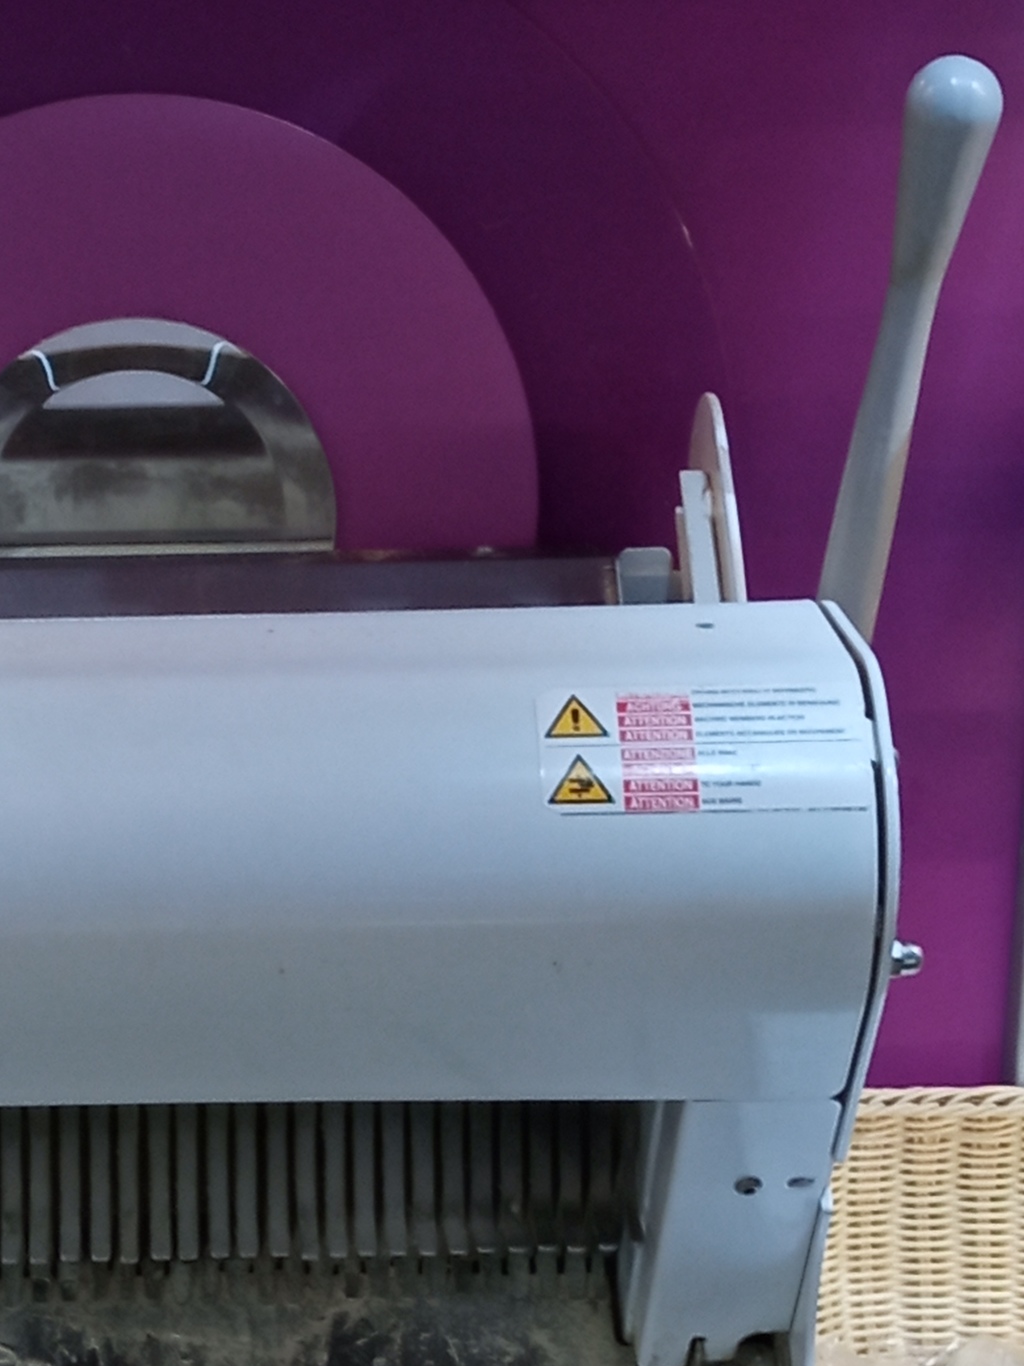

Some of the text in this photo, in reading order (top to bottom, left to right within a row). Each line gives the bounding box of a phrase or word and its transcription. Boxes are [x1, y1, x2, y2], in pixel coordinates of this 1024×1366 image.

[624, 714, 686, 726] ATTENTION
[626, 729, 687, 740] ATTENTION
[630, 780, 694, 792] ATTENTION
[630, 796, 694, 808] ATTENTION
